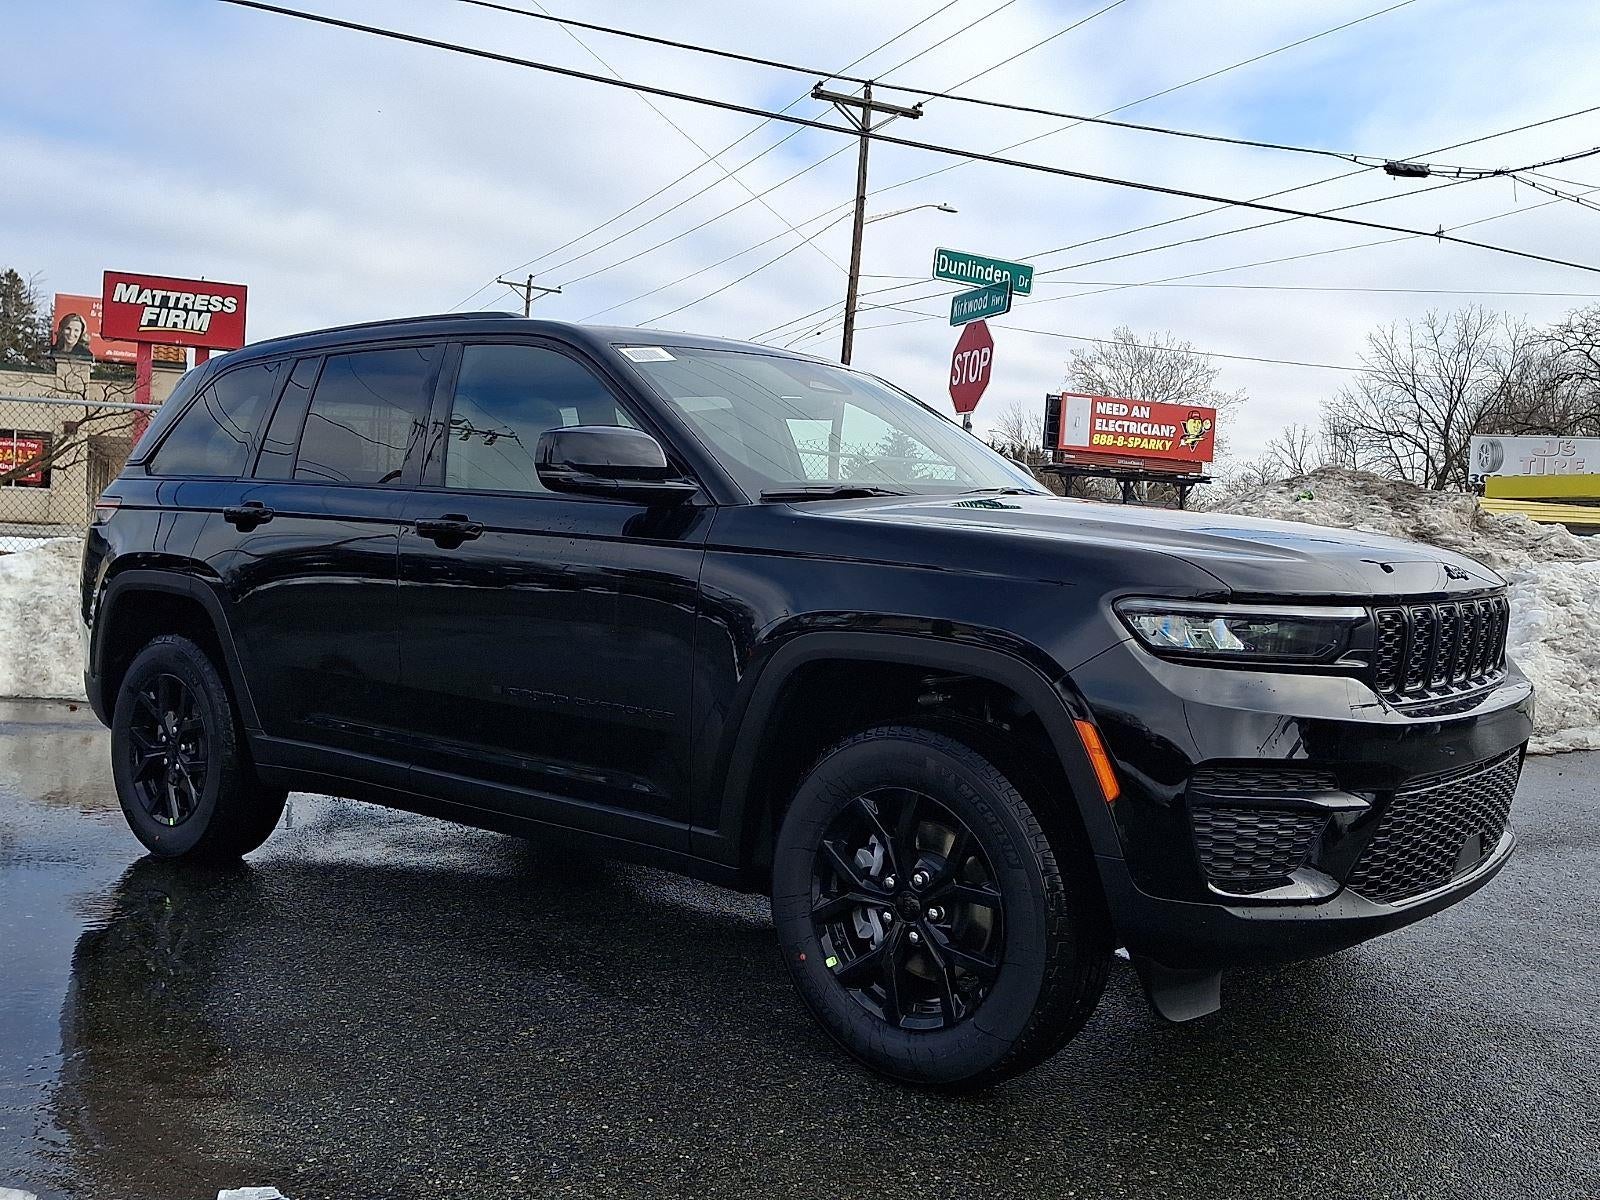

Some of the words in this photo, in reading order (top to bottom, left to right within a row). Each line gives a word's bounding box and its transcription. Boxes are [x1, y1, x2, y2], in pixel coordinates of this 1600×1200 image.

[938, 254, 1011, 282] Dunlinden
[1018, 275, 1030, 289] Dr
[952, 291, 989, 318] Kirkwood
[139, 306, 212, 332] FIRM
[952, 346, 991, 386] STOP
[1096, 401, 1129, 417] NEED
[1131, 405, 1151, 419] AN
[1094, 418, 1177, 438] ELECTRICIAN?
[1092, 433, 1173, 451] 888-8-SPARKY
[1520, 457, 1586, 476] TIRE
